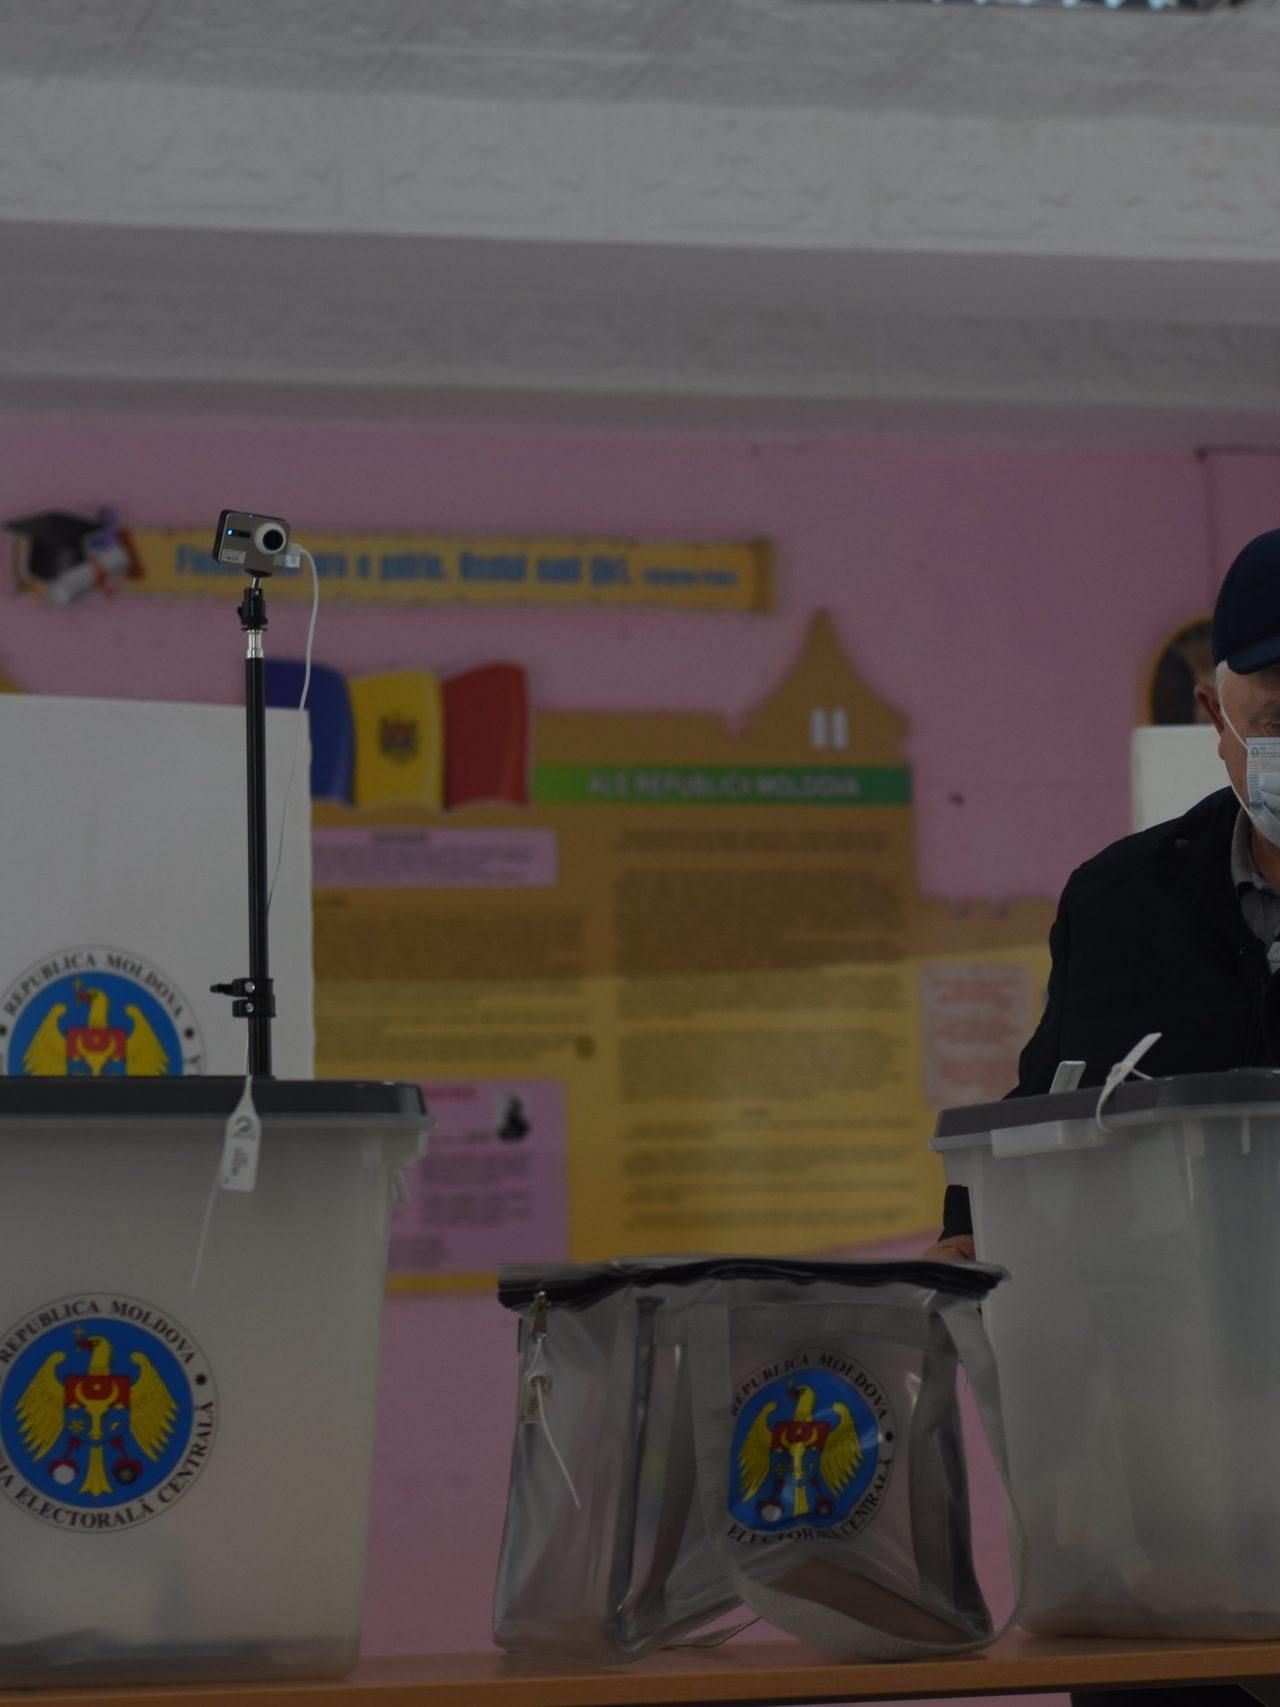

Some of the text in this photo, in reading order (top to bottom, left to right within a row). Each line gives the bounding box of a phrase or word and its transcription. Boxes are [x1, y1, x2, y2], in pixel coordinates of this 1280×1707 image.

[587, 771, 628, 798] ALE
[4, 953, 184, 1018] REPUBLICA MOLDOVA
[0, 1300, 196, 1364] REPUBLICA MOLDOVA
[819, 1353, 888, 1420] MOLDOVA
[15, 1400, 214, 1529] ELECTORALĂ CENTRALĂ
